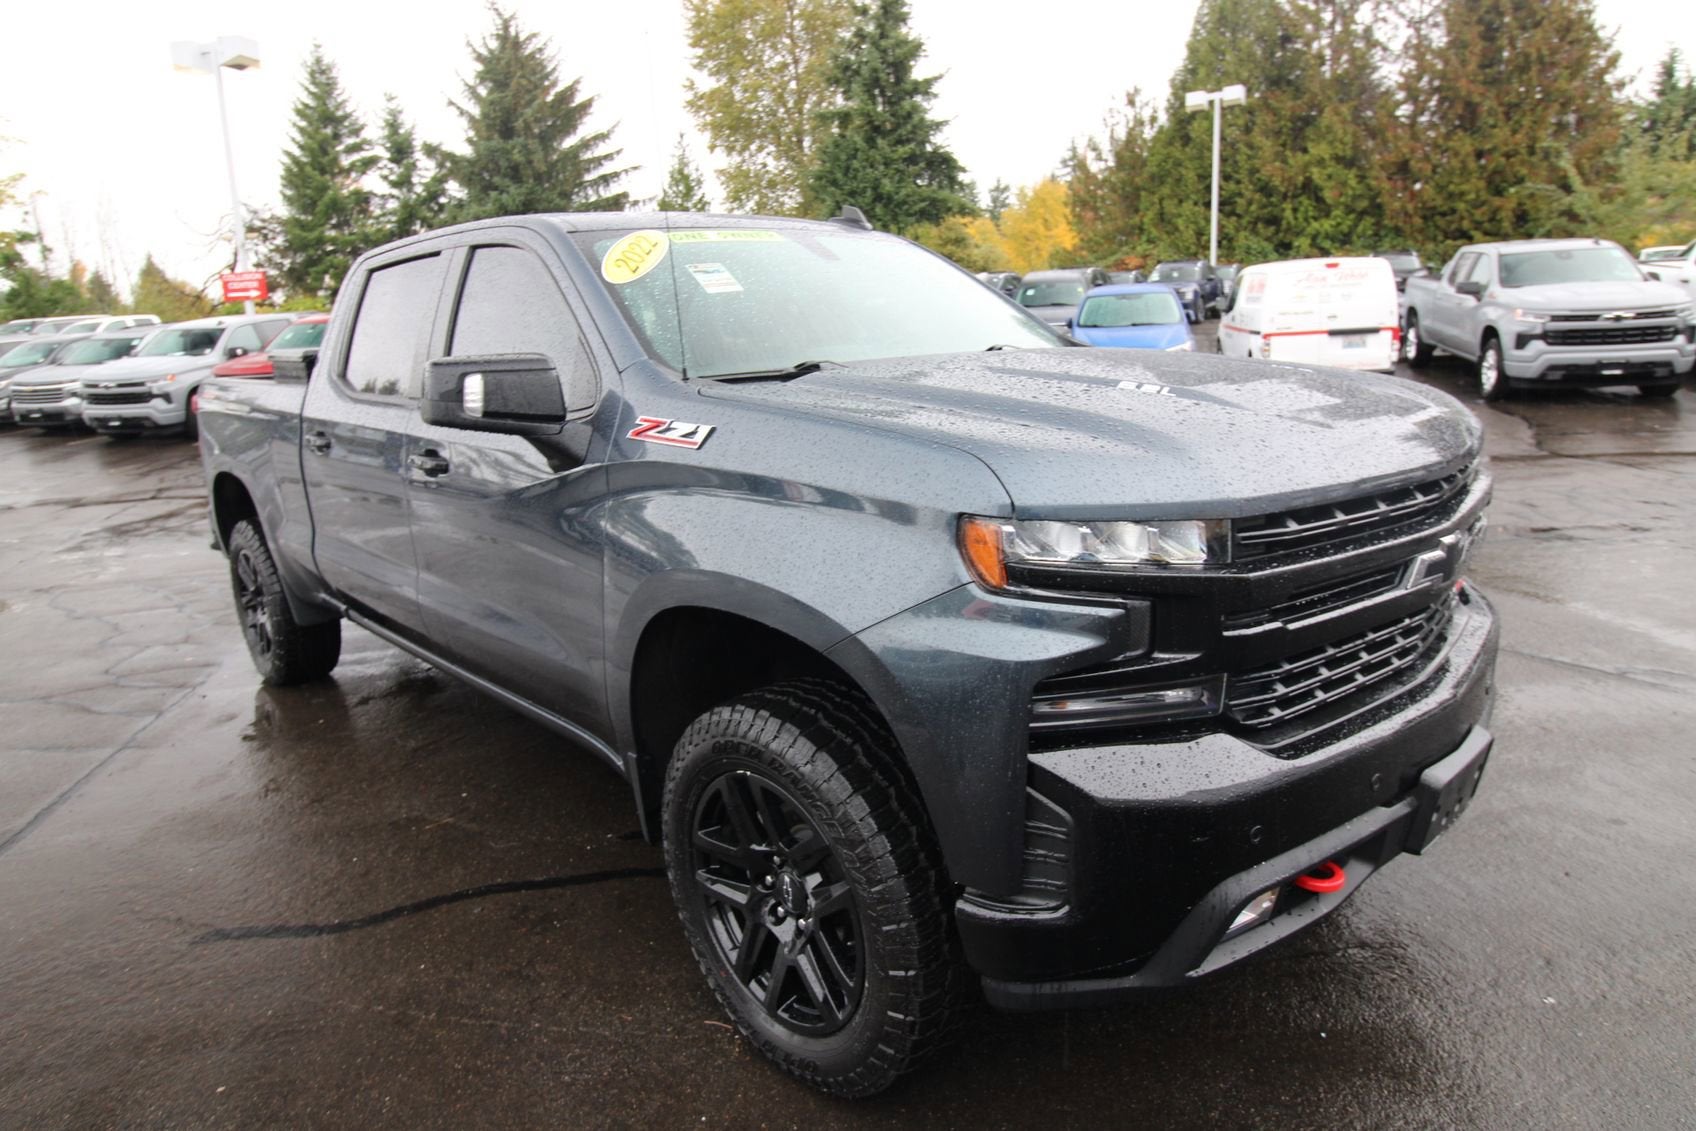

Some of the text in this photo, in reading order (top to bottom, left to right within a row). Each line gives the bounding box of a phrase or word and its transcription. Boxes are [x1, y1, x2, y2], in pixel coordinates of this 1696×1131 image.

[614, 235, 660, 274] 2022
[227, 280, 260, 290] CENTER
[625, 415, 717, 450] Z71
